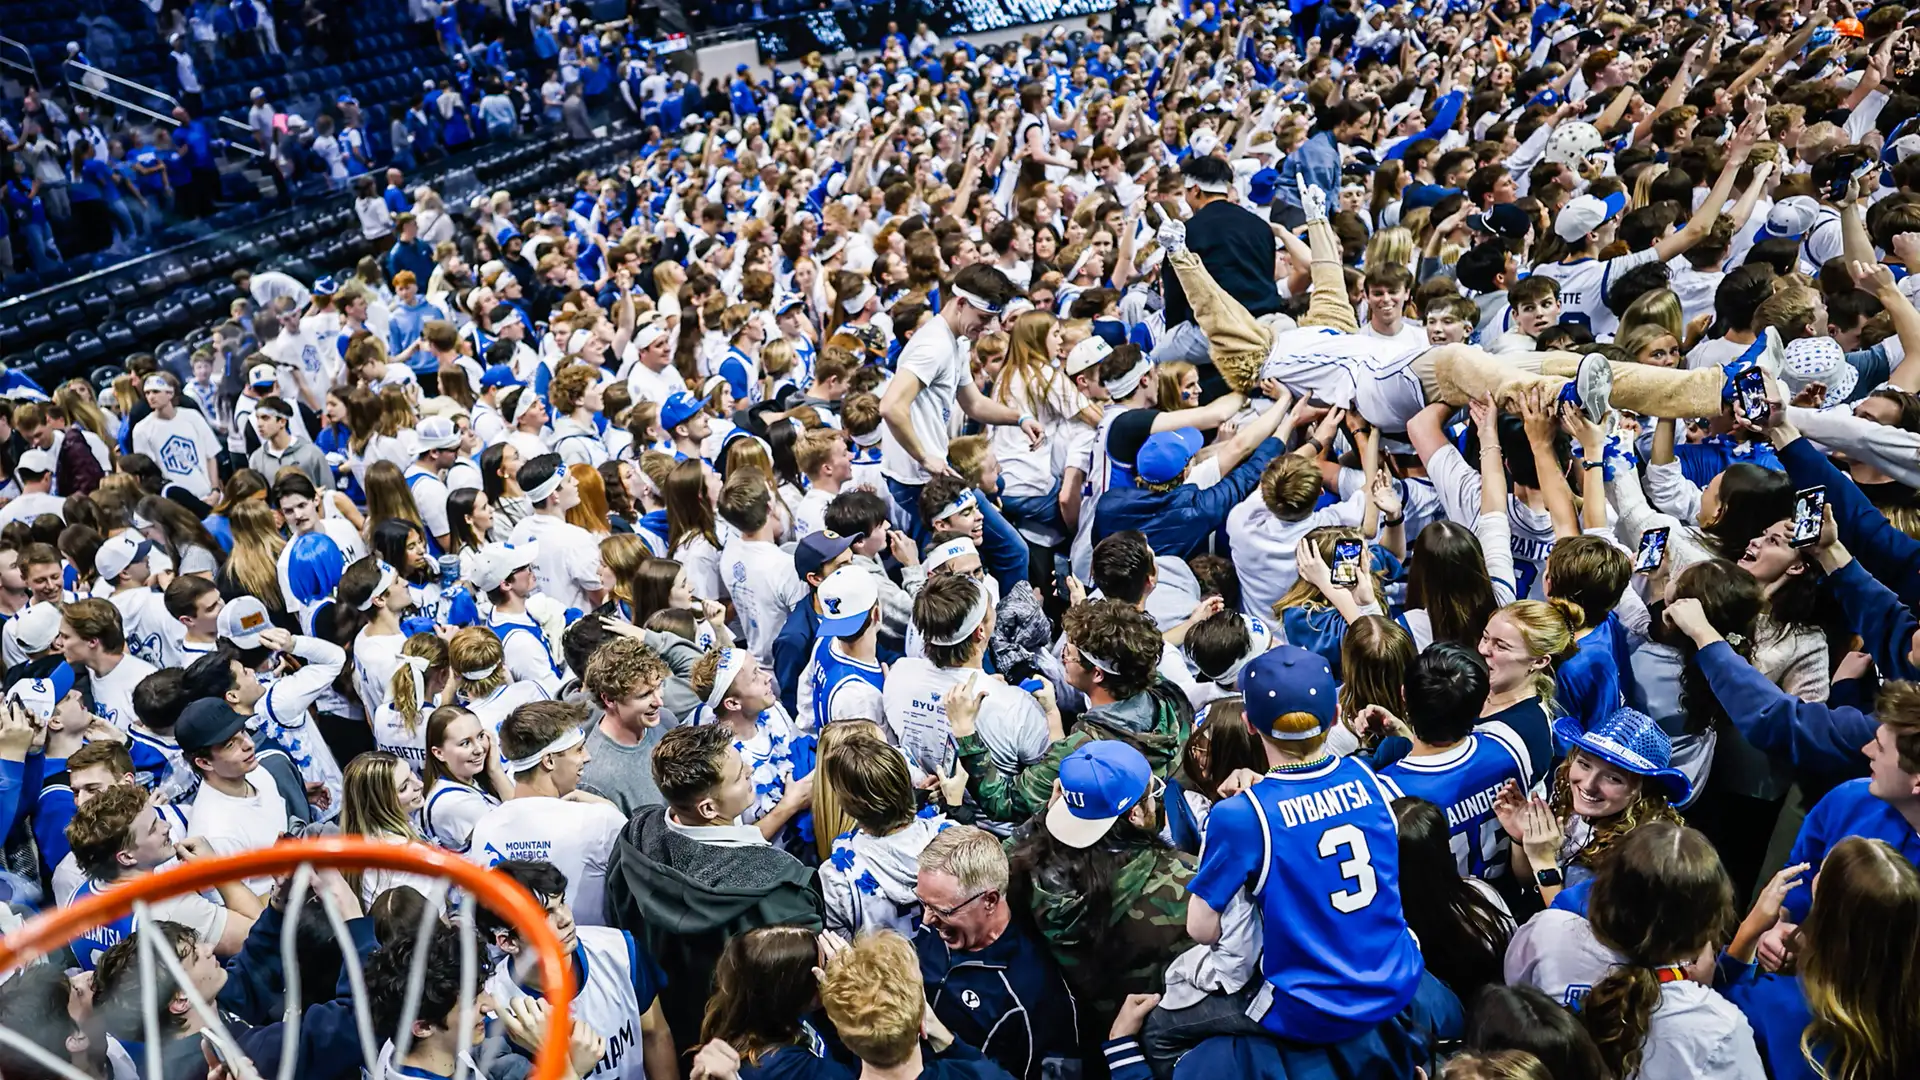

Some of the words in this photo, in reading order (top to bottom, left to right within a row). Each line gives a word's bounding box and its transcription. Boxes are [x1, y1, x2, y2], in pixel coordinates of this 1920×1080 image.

[947, 545, 966, 556] BYU
[912, 700, 935, 712] BYU
[1278, 780, 1372, 828] DYBANTSA
[506, 841, 551, 853] MOUNTAIN
[510, 851, 549, 861] AMERICA
[1318, 823, 1378, 914] 3
